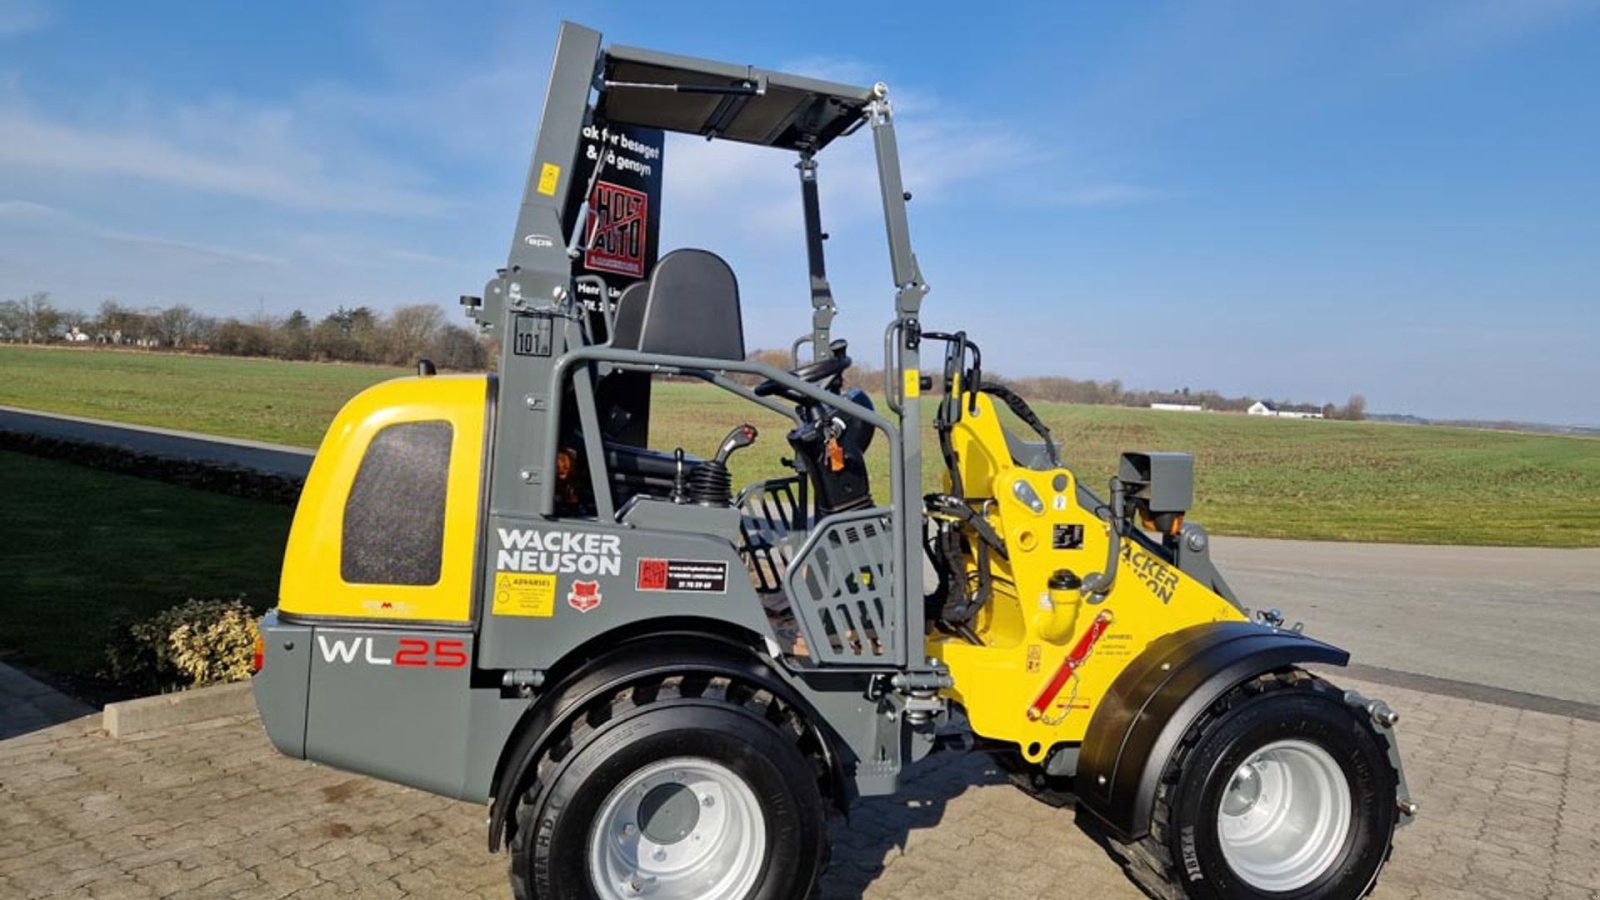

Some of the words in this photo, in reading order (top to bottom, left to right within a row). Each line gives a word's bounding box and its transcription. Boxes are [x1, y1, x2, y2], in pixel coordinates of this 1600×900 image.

[582, 125, 599, 140] ak
[620, 133, 659, 159] besøget
[586, 145, 597, 159] &
[617, 156, 651, 177] gensyn
[597, 187, 642, 226] HOLT
[593, 218, 641, 259] AUTO
[577, 283, 600, 295] Henr
[519, 332, 540, 354] 101
[497, 528, 621, 555] WACKER
[497, 550, 621, 576] NEUSON
[1121, 543, 1180, 590] ACKER
[318, 636, 467, 667] WL25
